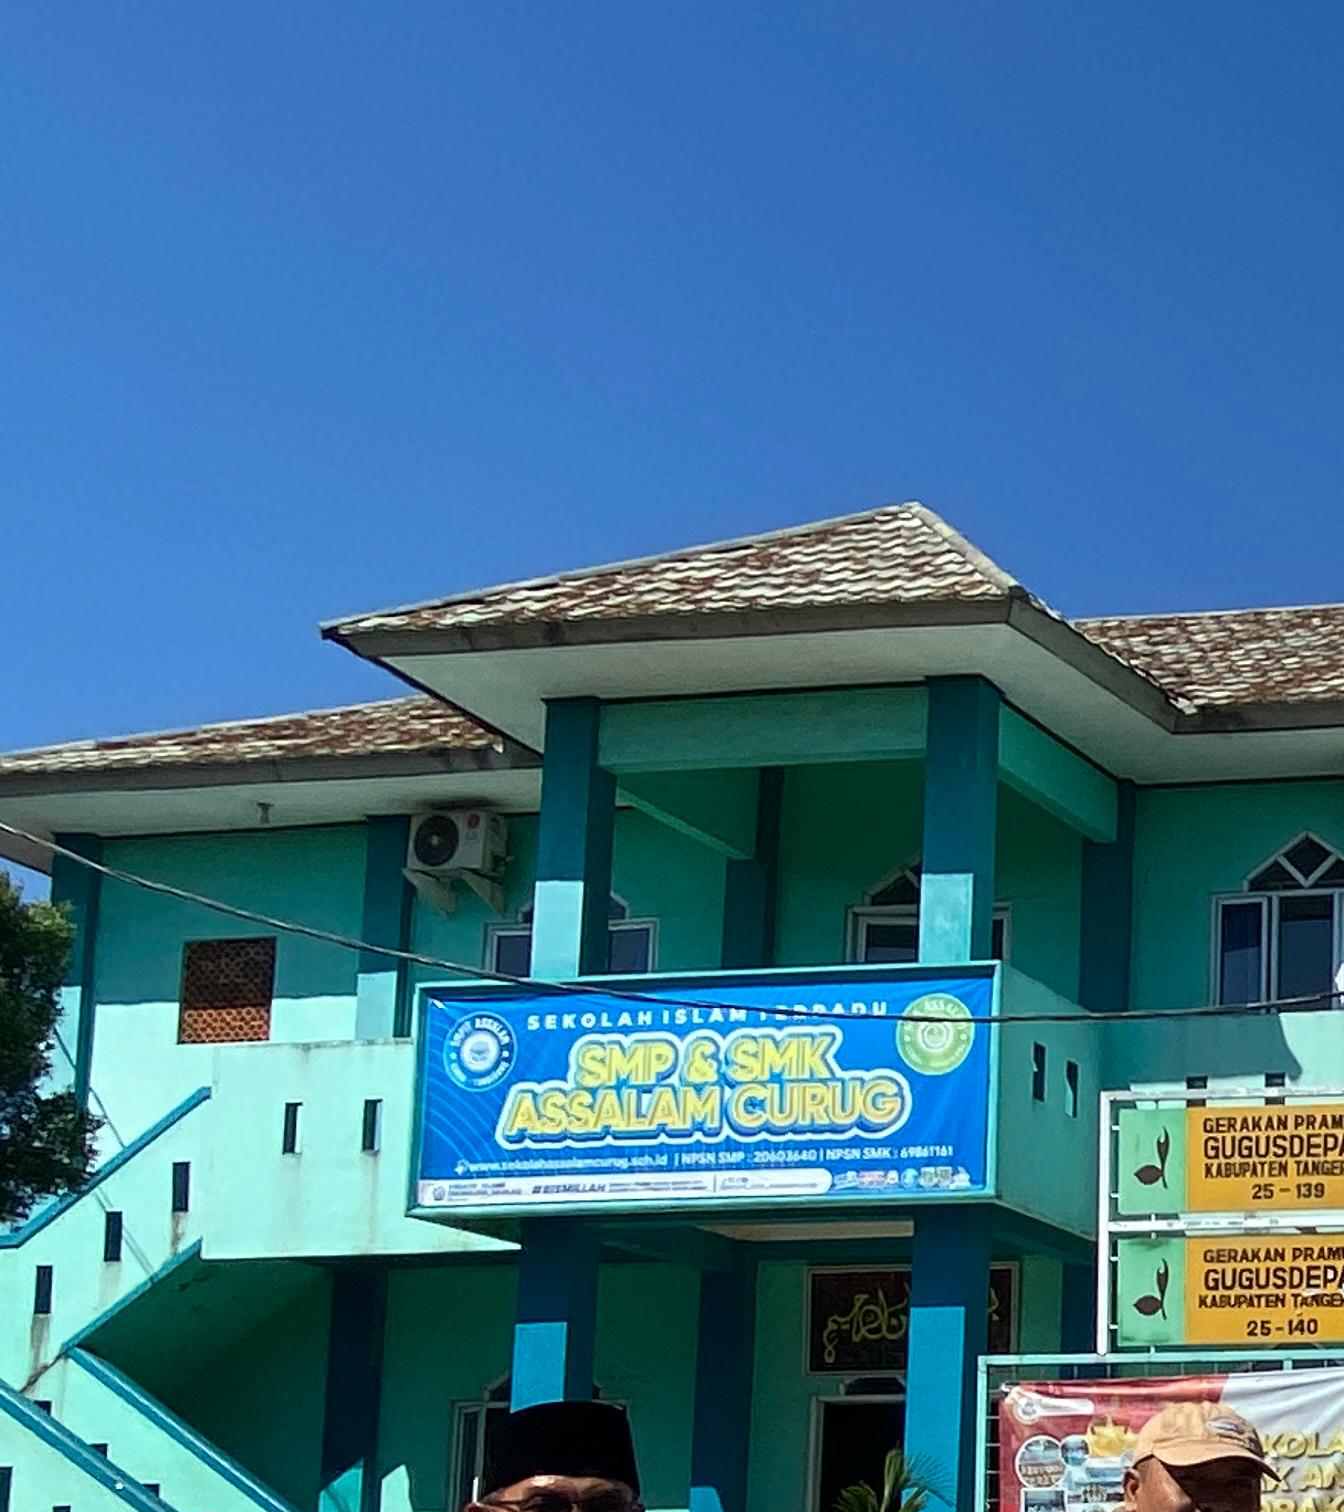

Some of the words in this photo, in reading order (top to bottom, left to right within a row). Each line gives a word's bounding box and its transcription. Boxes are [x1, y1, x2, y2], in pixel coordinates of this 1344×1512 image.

[526, 1011, 652, 1031] SEKOLAH
[662, 1005, 747, 1024] ISLAM
[574, 1041, 676, 1086] SMP
[685, 1040, 719, 1083] &
[729, 1035, 834, 1083] SMK
[504, 1087, 722, 1134] ASSALAM
[732, 1077, 900, 1129] CURUG
[1203, 1115, 1288, 1133] GERAKAN
[1204, 1161, 1288, 1178] KABUPATEN
[1203, 1248, 1285, 1263] GERAKAN
[1198, 1293, 1286, 1308] KABUPATEN
